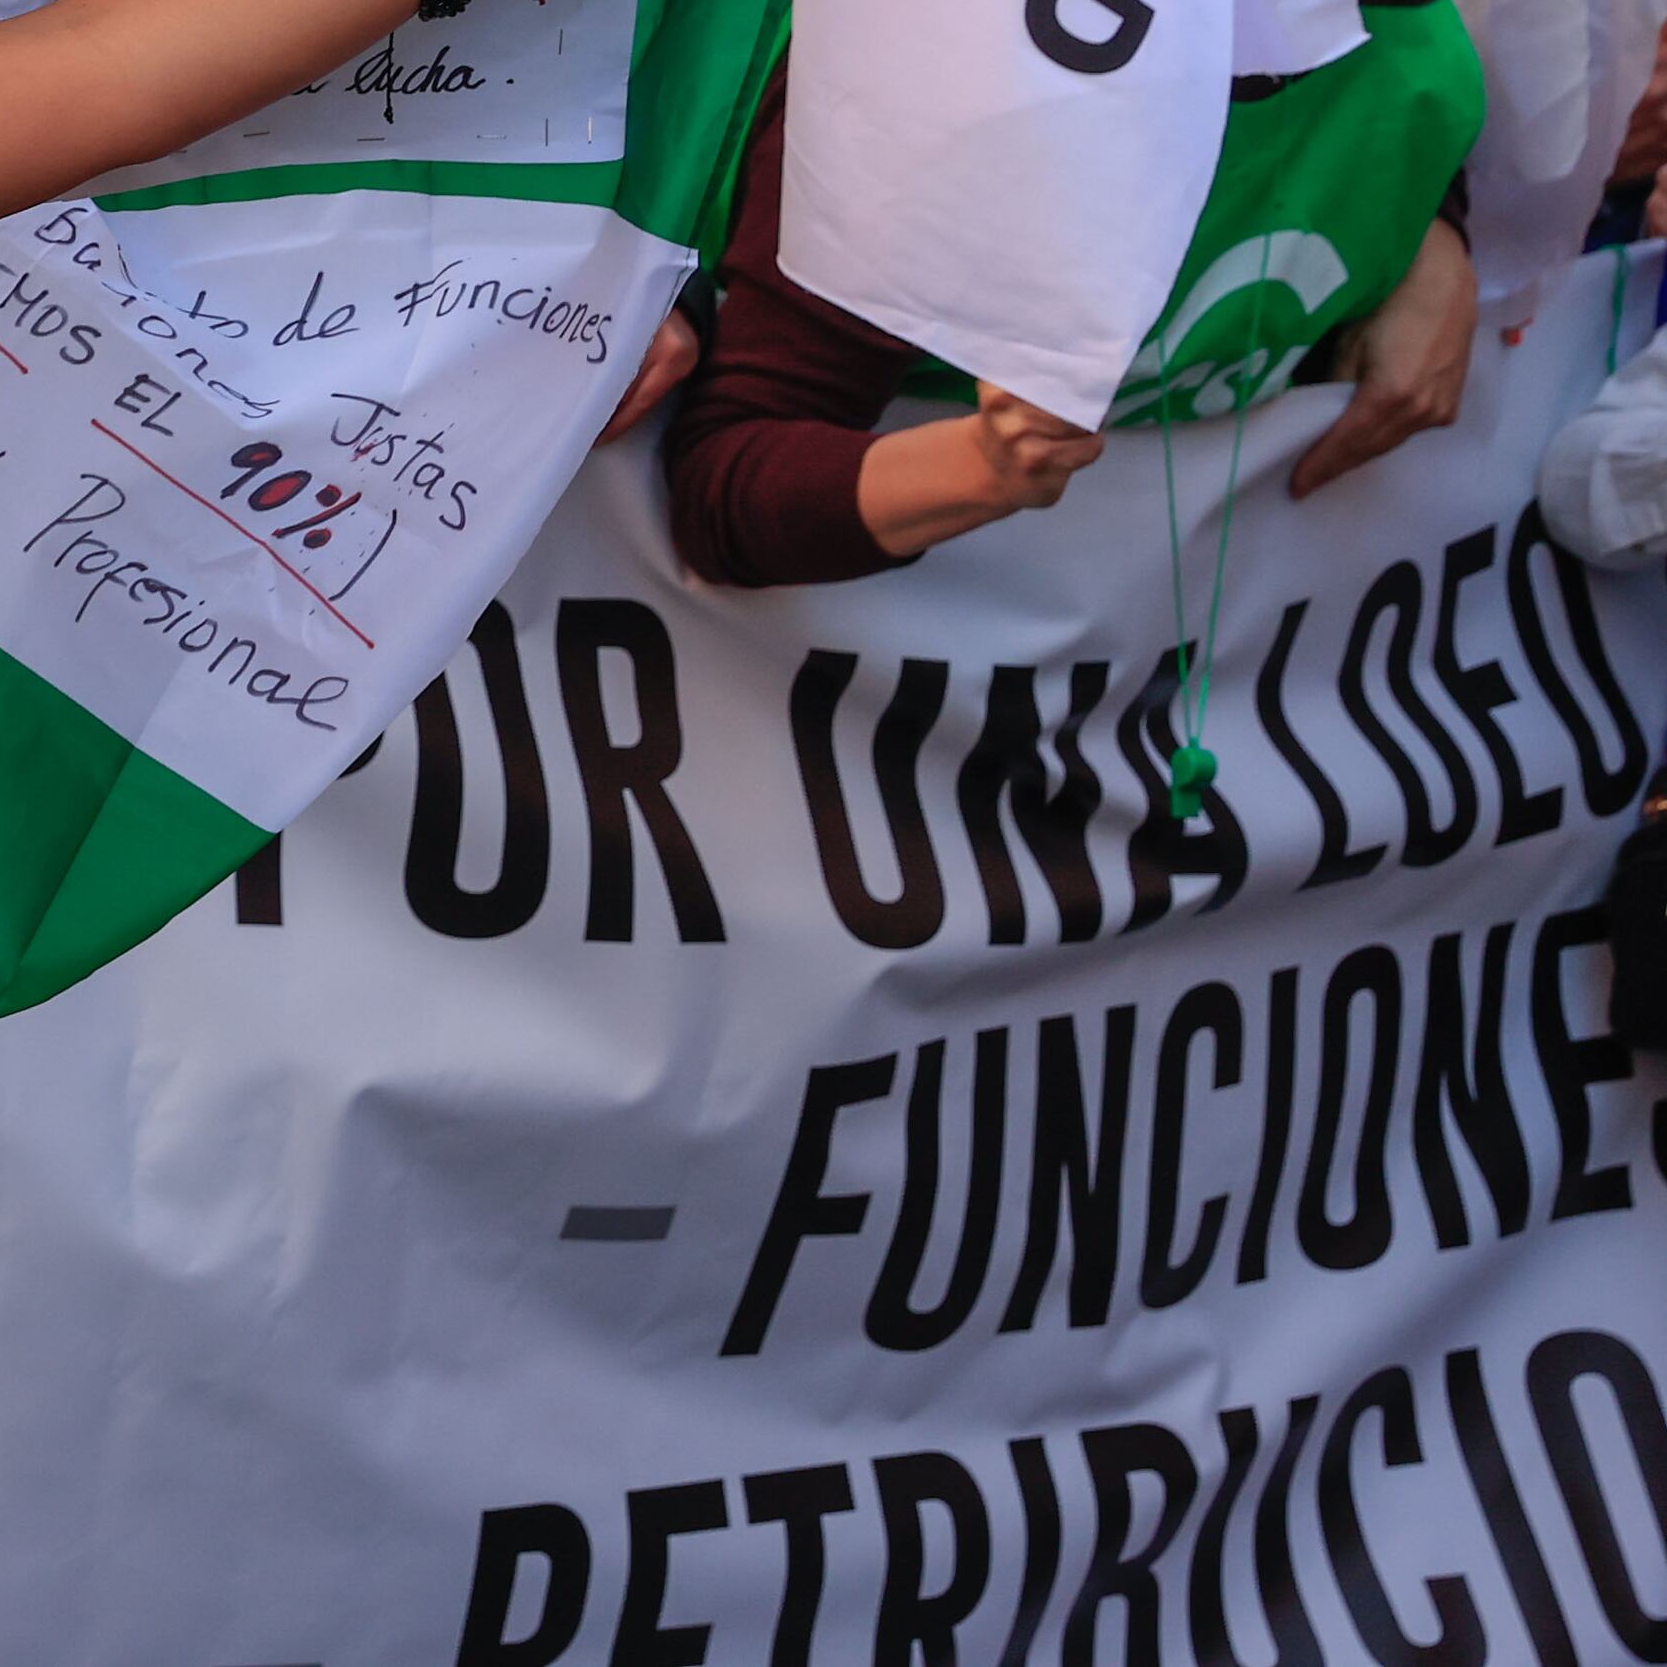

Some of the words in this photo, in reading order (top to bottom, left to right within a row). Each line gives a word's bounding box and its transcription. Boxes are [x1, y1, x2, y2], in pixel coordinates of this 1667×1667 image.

[272, 270, 361, 347] de
[394, 259, 613, 364] Funciones
[113, 373, 184, 437] EL
[330, 391, 478, 533] Justas
[236, 596, 727, 943] OR
[789, 638, 1248, 950] UNA
[718, 905, 1667, 1357] FUNCIONE
